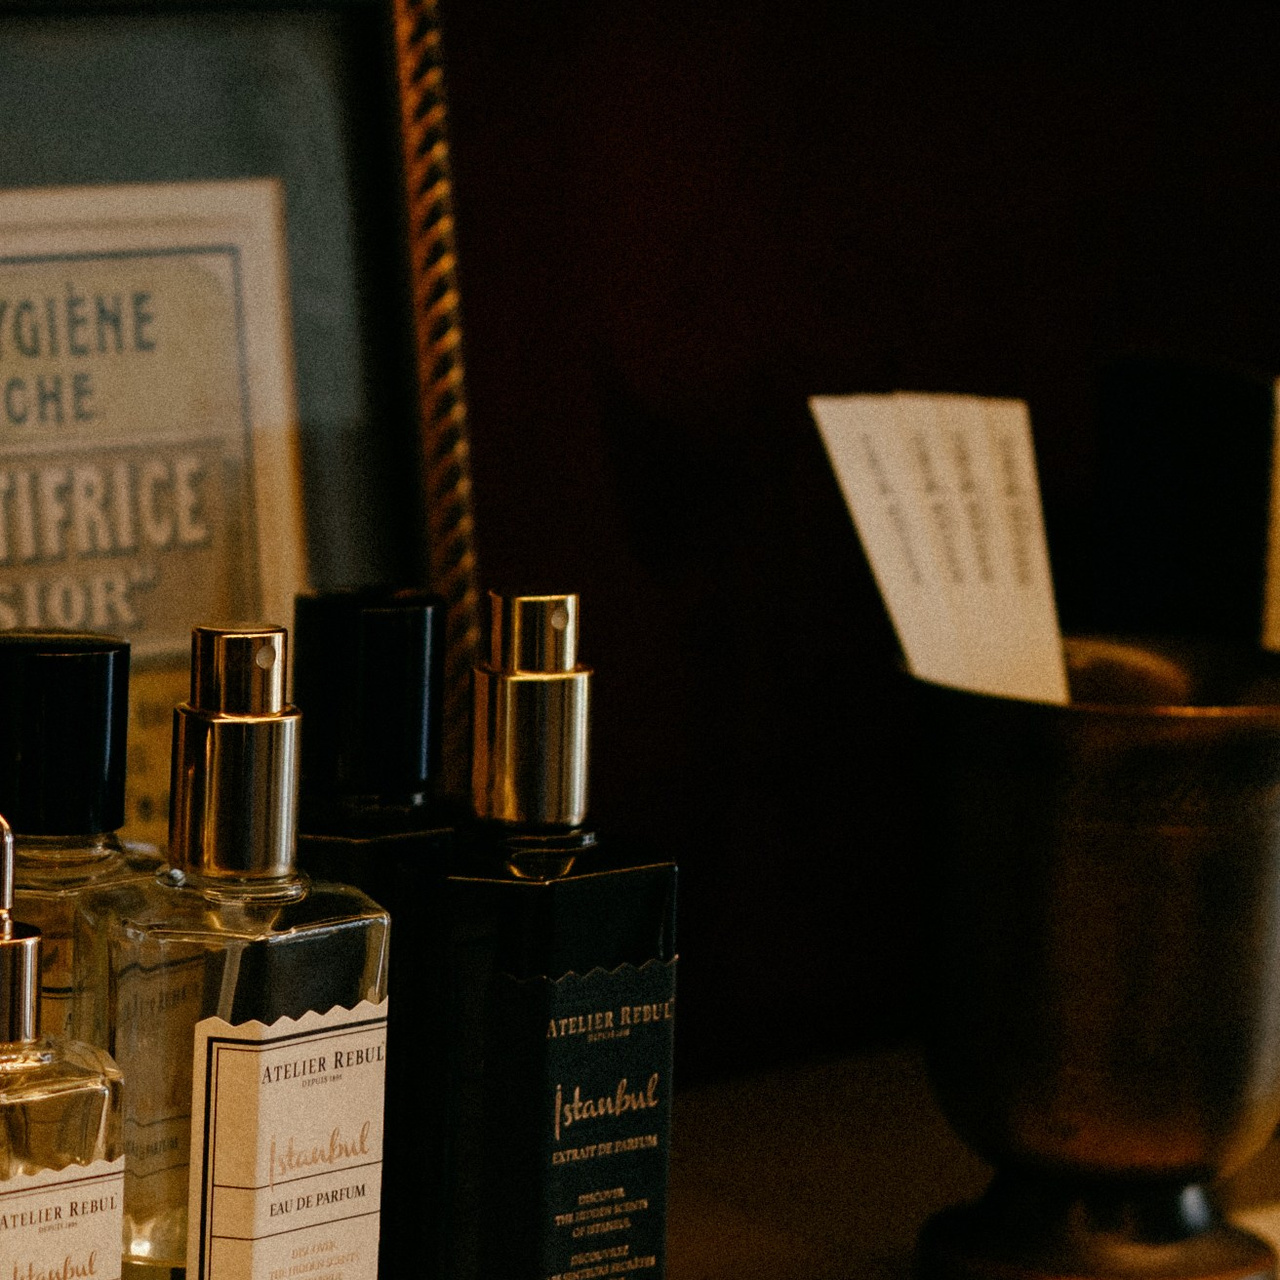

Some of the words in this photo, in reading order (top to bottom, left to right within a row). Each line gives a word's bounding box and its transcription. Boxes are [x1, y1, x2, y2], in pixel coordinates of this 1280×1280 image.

[546, 1011, 614, 1038] ATELIER
[261, 1056, 327, 1085] ATELIER
[334, 1045, 384, 1070] REBUL
[301, 1075, 328, 1088] DEPUIS
[552, 1144, 596, 1166] EXTRAIT
[598, 1141, 613, 1156] DE
[615, 1133, 658, 1153] PARFUM
[0, 1206, 62, 1231] ATELIER
[70, 1195, 118, 1218] REBUL
[270, 1200, 293, 1217] EAU
[296, 1195, 313, 1211] DE
[316, 1183, 366, 1207] PARFUM
